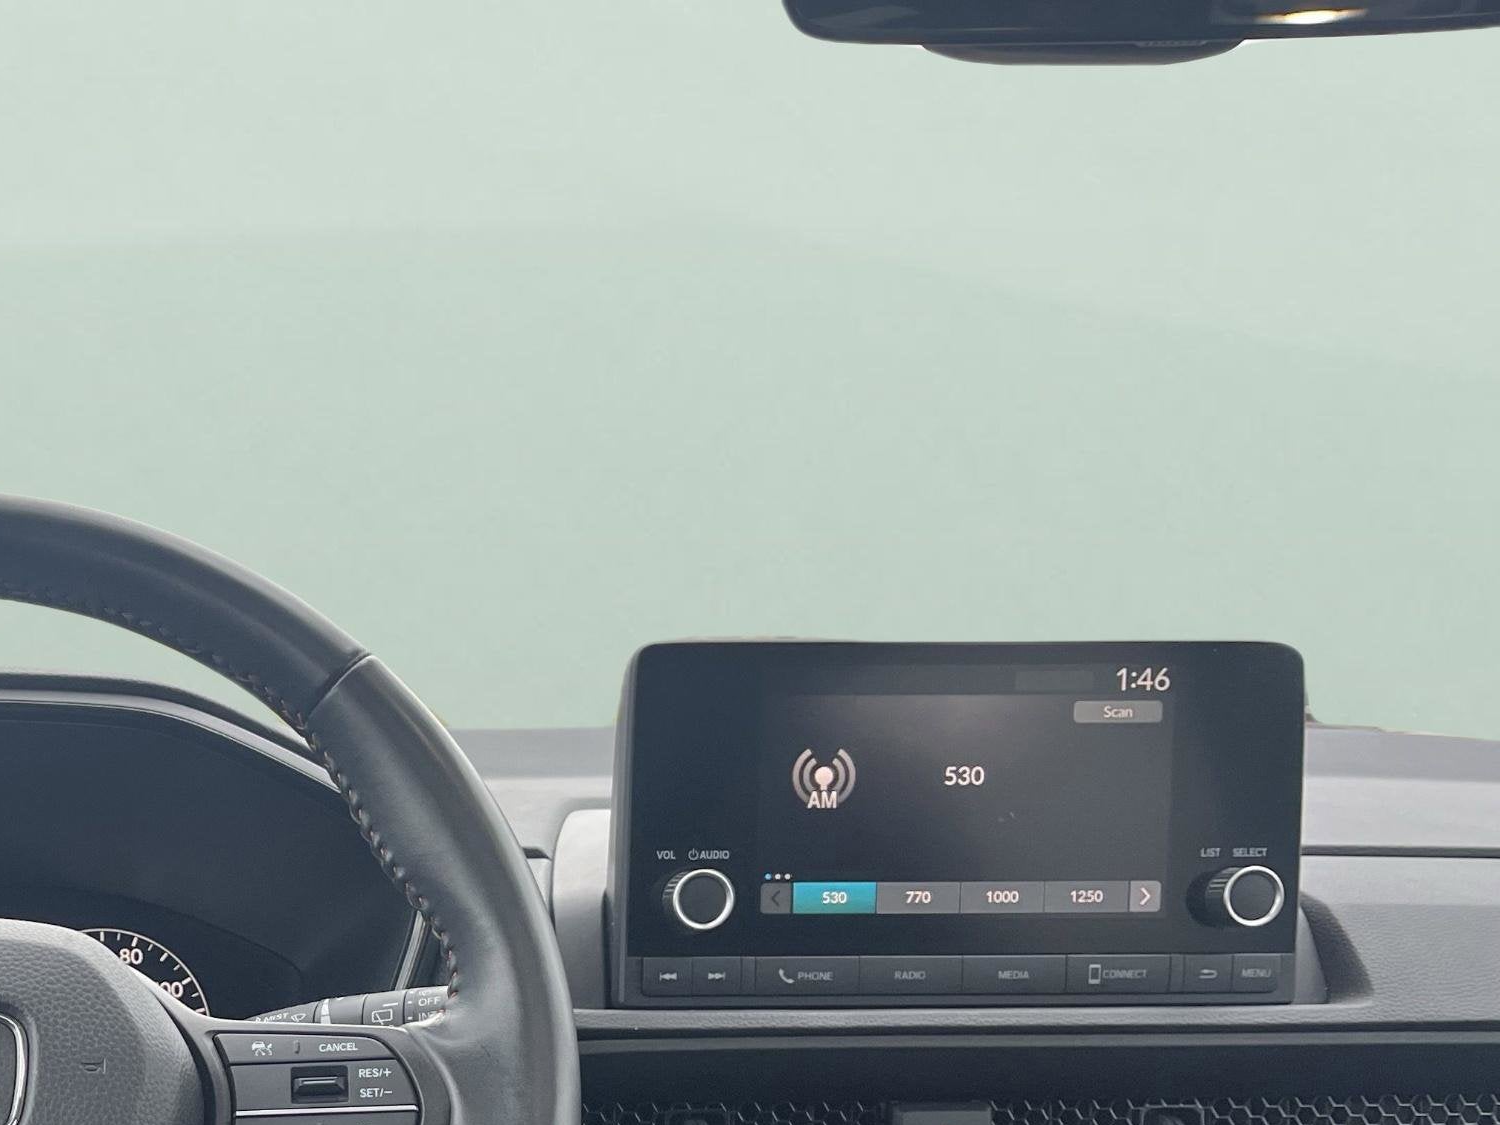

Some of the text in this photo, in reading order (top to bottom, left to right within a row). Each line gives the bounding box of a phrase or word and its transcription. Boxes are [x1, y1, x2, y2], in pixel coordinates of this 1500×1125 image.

[1116, 667, 1171, 691] 1:46
[1103, 705, 1133, 718] Scan
[944, 766, 985, 786] 530
[807, 790, 838, 809] AM
[656, 850, 676, 860] VOL
[699, 850, 730, 860] AUDIO
[1200, 847, 1220, 858] LIST
[1232, 847, 1268, 858] SELECT
[822, 890, 847, 904] 530
[905, 890, 931, 904] 770
[986, 889, 1019, 904] 1000
[1070, 889, 1104, 904] 1250
[119, 948, 144, 965] 80
[797, 971, 834, 981] PHONE
[894, 970, 927, 981] RADIO
[998, 970, 1031, 980] MEDIA
[1102, 968, 1148, 980] CONNECT
[1241, 968, 1273, 979] MENU
[418, 996, 441, 1006] OFF
[318, 1042, 359, 1053] CANCEL
[358, 1068, 392, 1078] RES/+
